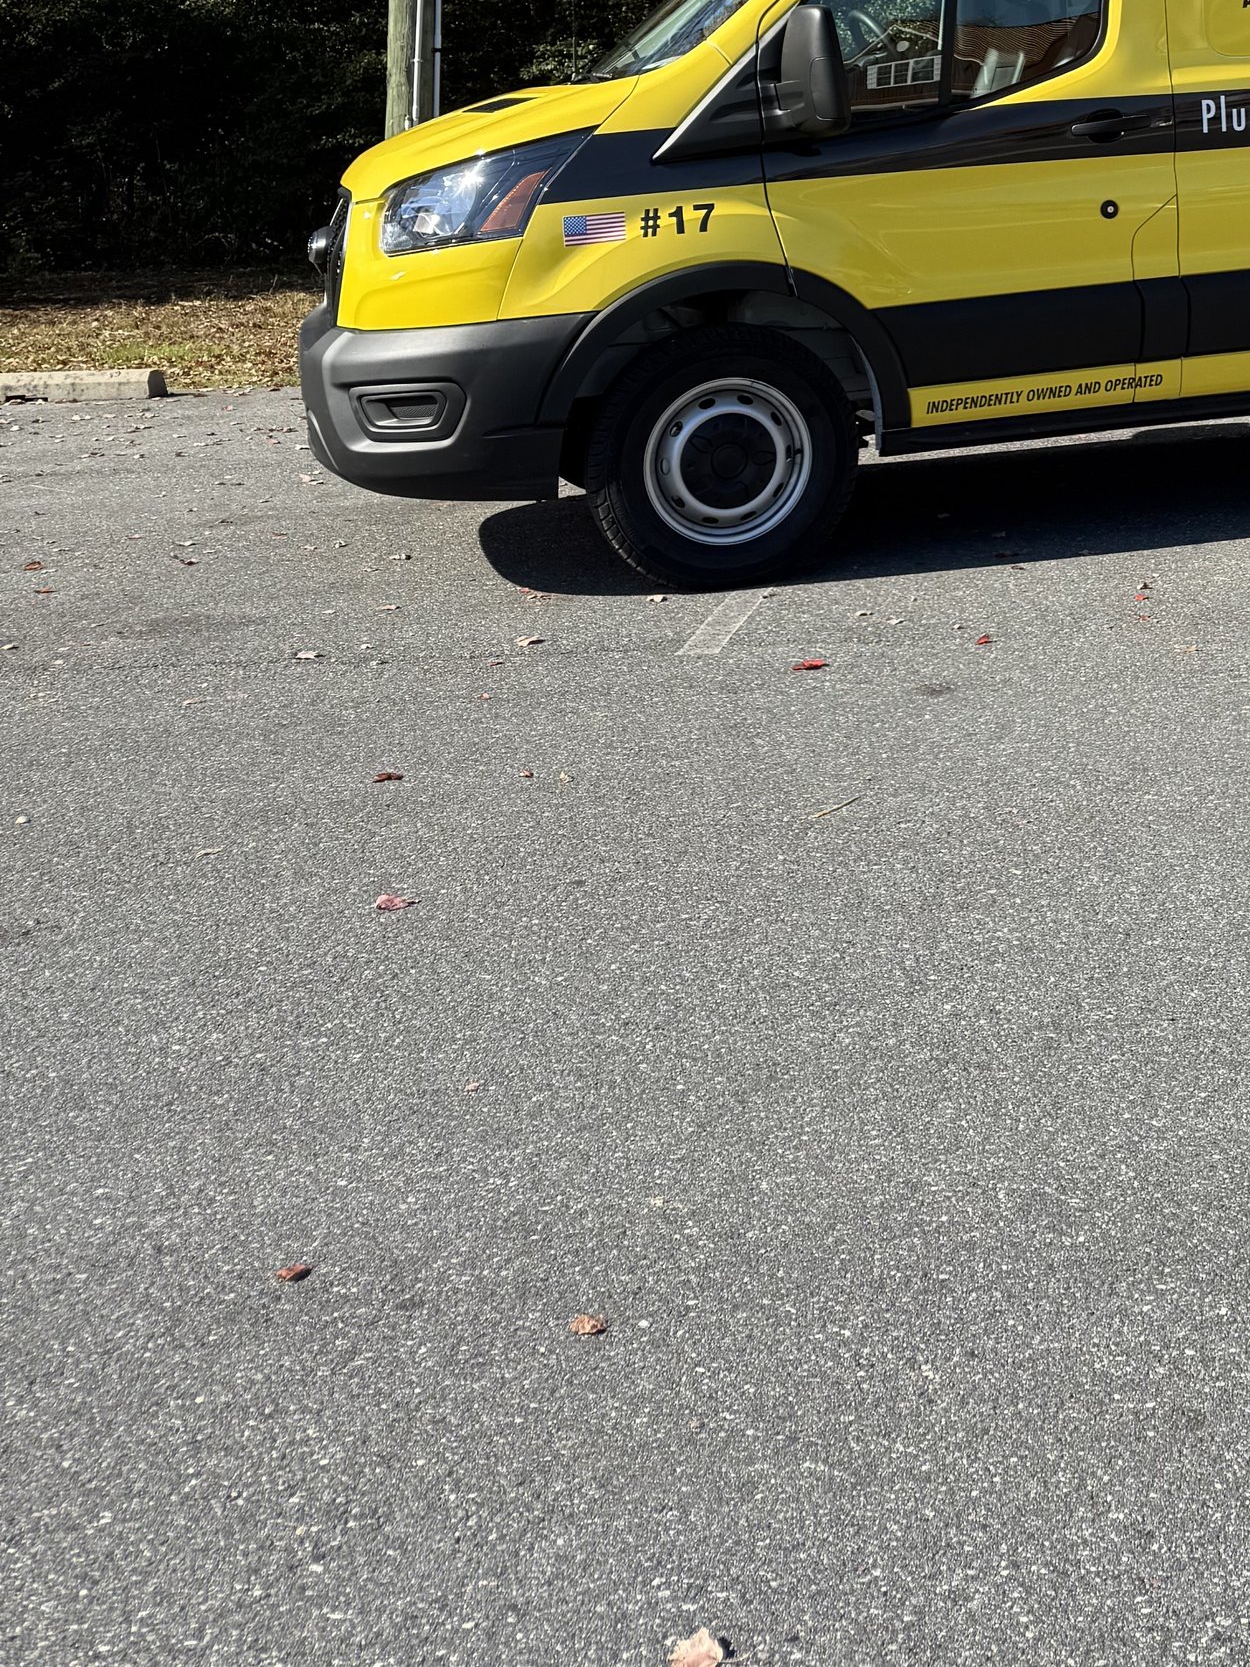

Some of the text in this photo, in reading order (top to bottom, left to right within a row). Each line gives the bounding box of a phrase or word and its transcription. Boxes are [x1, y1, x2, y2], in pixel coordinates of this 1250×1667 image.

[640, 203, 715, 238] #17
[926, 374, 1163, 415] INDEPENDENTLY OWNED AND OPERATED
